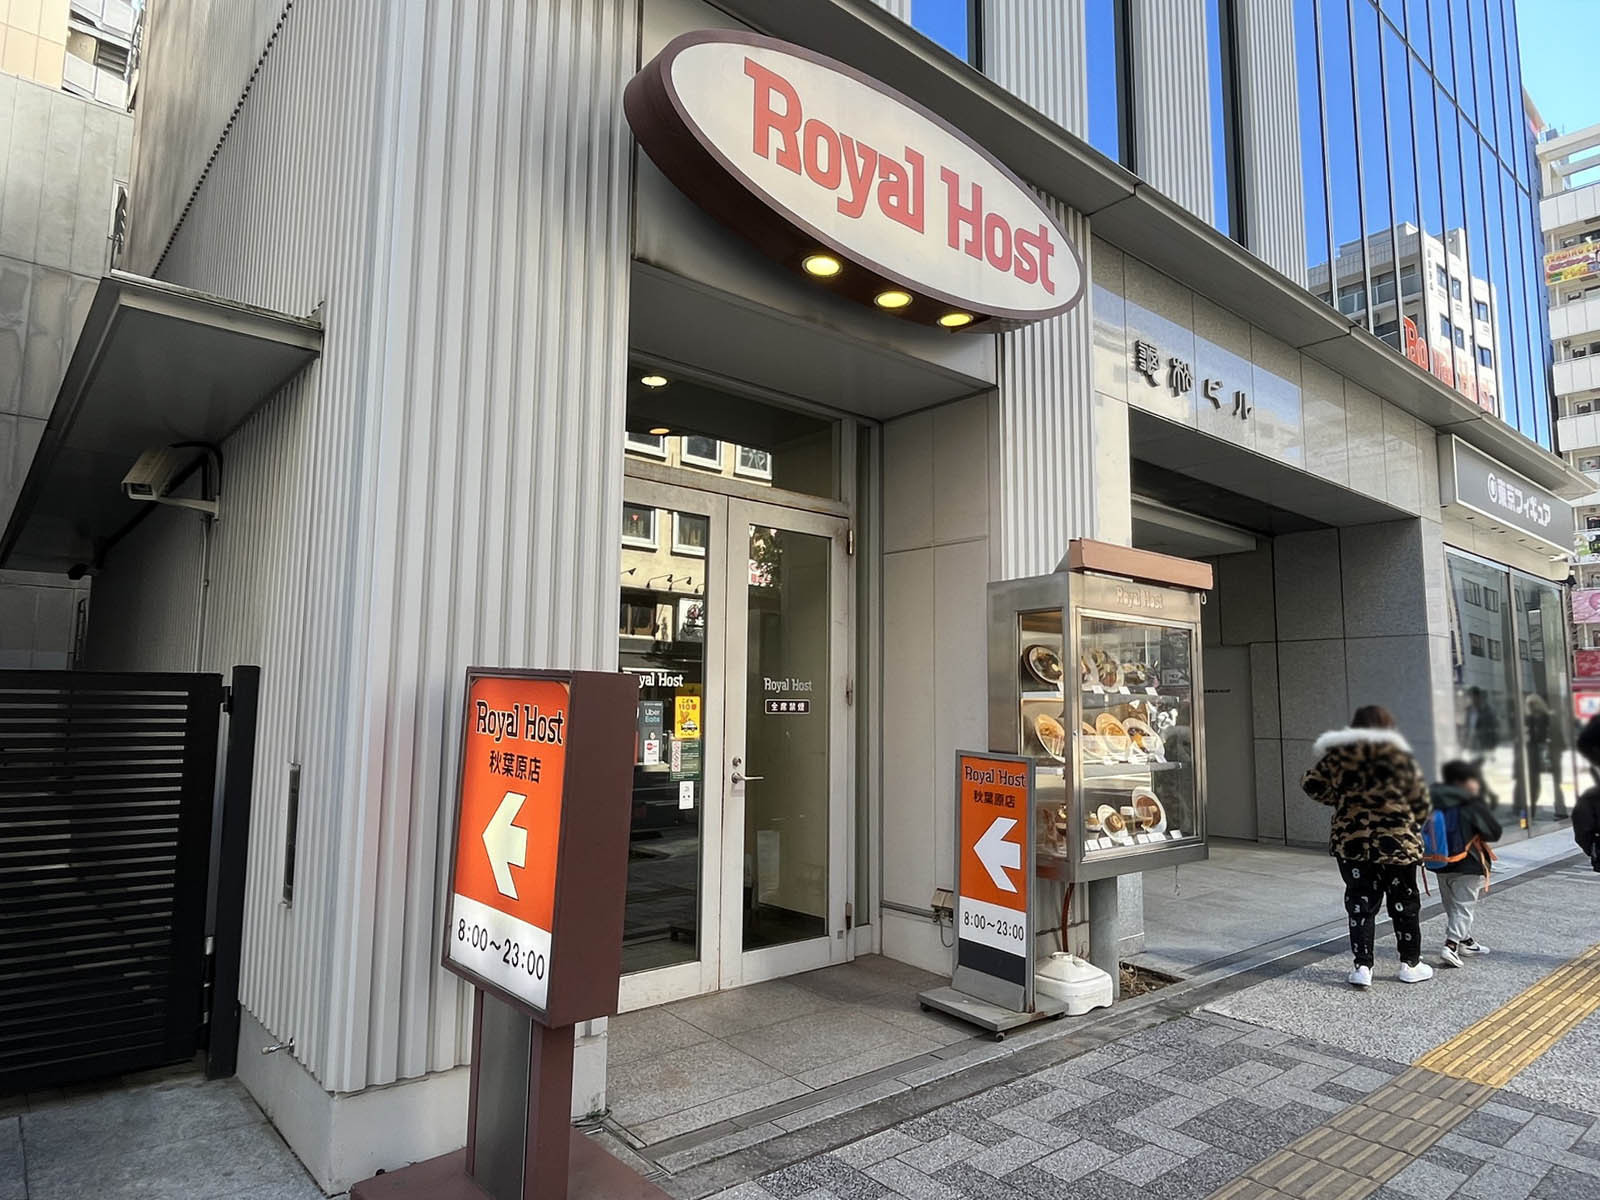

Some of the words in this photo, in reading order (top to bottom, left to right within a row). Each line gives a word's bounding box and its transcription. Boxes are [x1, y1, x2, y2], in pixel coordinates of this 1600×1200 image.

[744, 57, 925, 234] Royal
[940, 165, 1055, 296] Host
[657, 671, 684, 687] Host
[763, 677, 790, 693] Royal
[791, 678, 813, 691] Host
[645, 708, 660, 716] Uber
[475, 699, 521, 743] Royal
[523, 704, 564, 746] Host
[488, 749, 541, 784] 秋葉原店
[965, 765, 995, 784] Royal
[998, 769, 1025, 787] Host
[974, 789, 1016, 808] 秋葉原店
